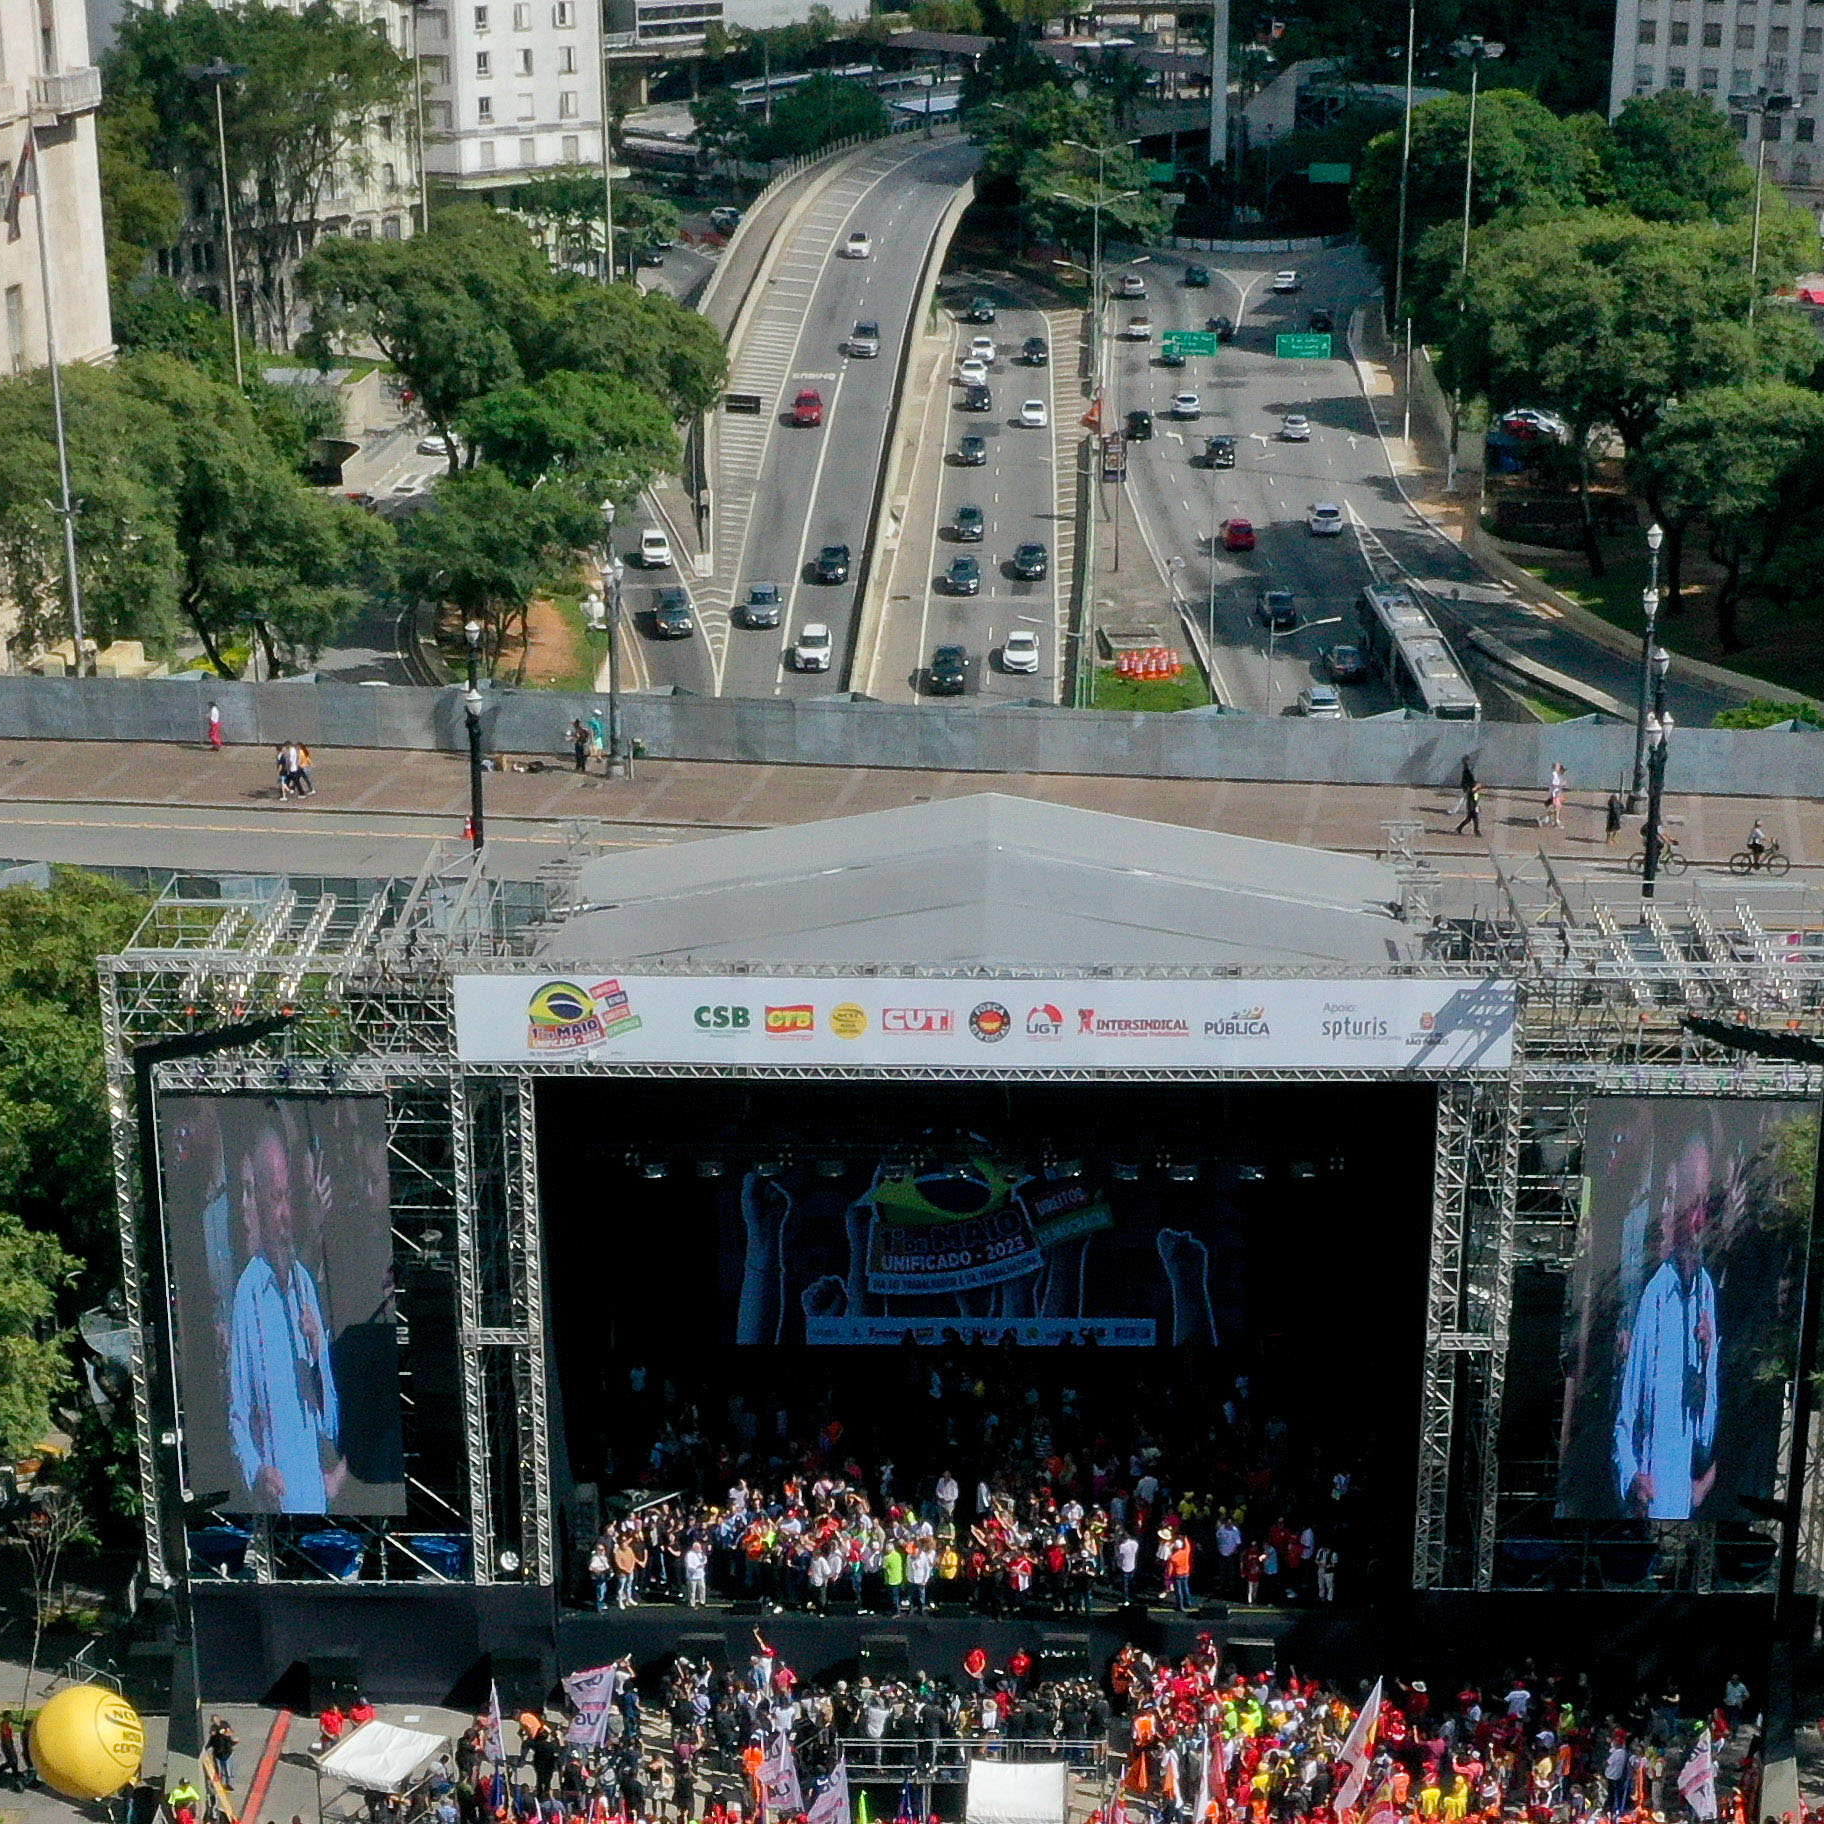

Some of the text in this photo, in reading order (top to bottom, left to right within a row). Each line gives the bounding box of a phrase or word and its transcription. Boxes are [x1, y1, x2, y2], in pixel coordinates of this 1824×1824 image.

[694, 1005, 751, 1028] CSB
[884, 1010, 948, 1030] CUT
[1096, 1019, 1189, 1031] INTERSINDICAL
[1204, 1018, 1270, 1035] PÚBLICA
[557, 1019, 599, 1039] MAIO
[1026, 1023, 1062, 1034] UGT
[1322, 1015, 1388, 1042] spturis
[881, 1250, 973, 1272] UNIFICADO
